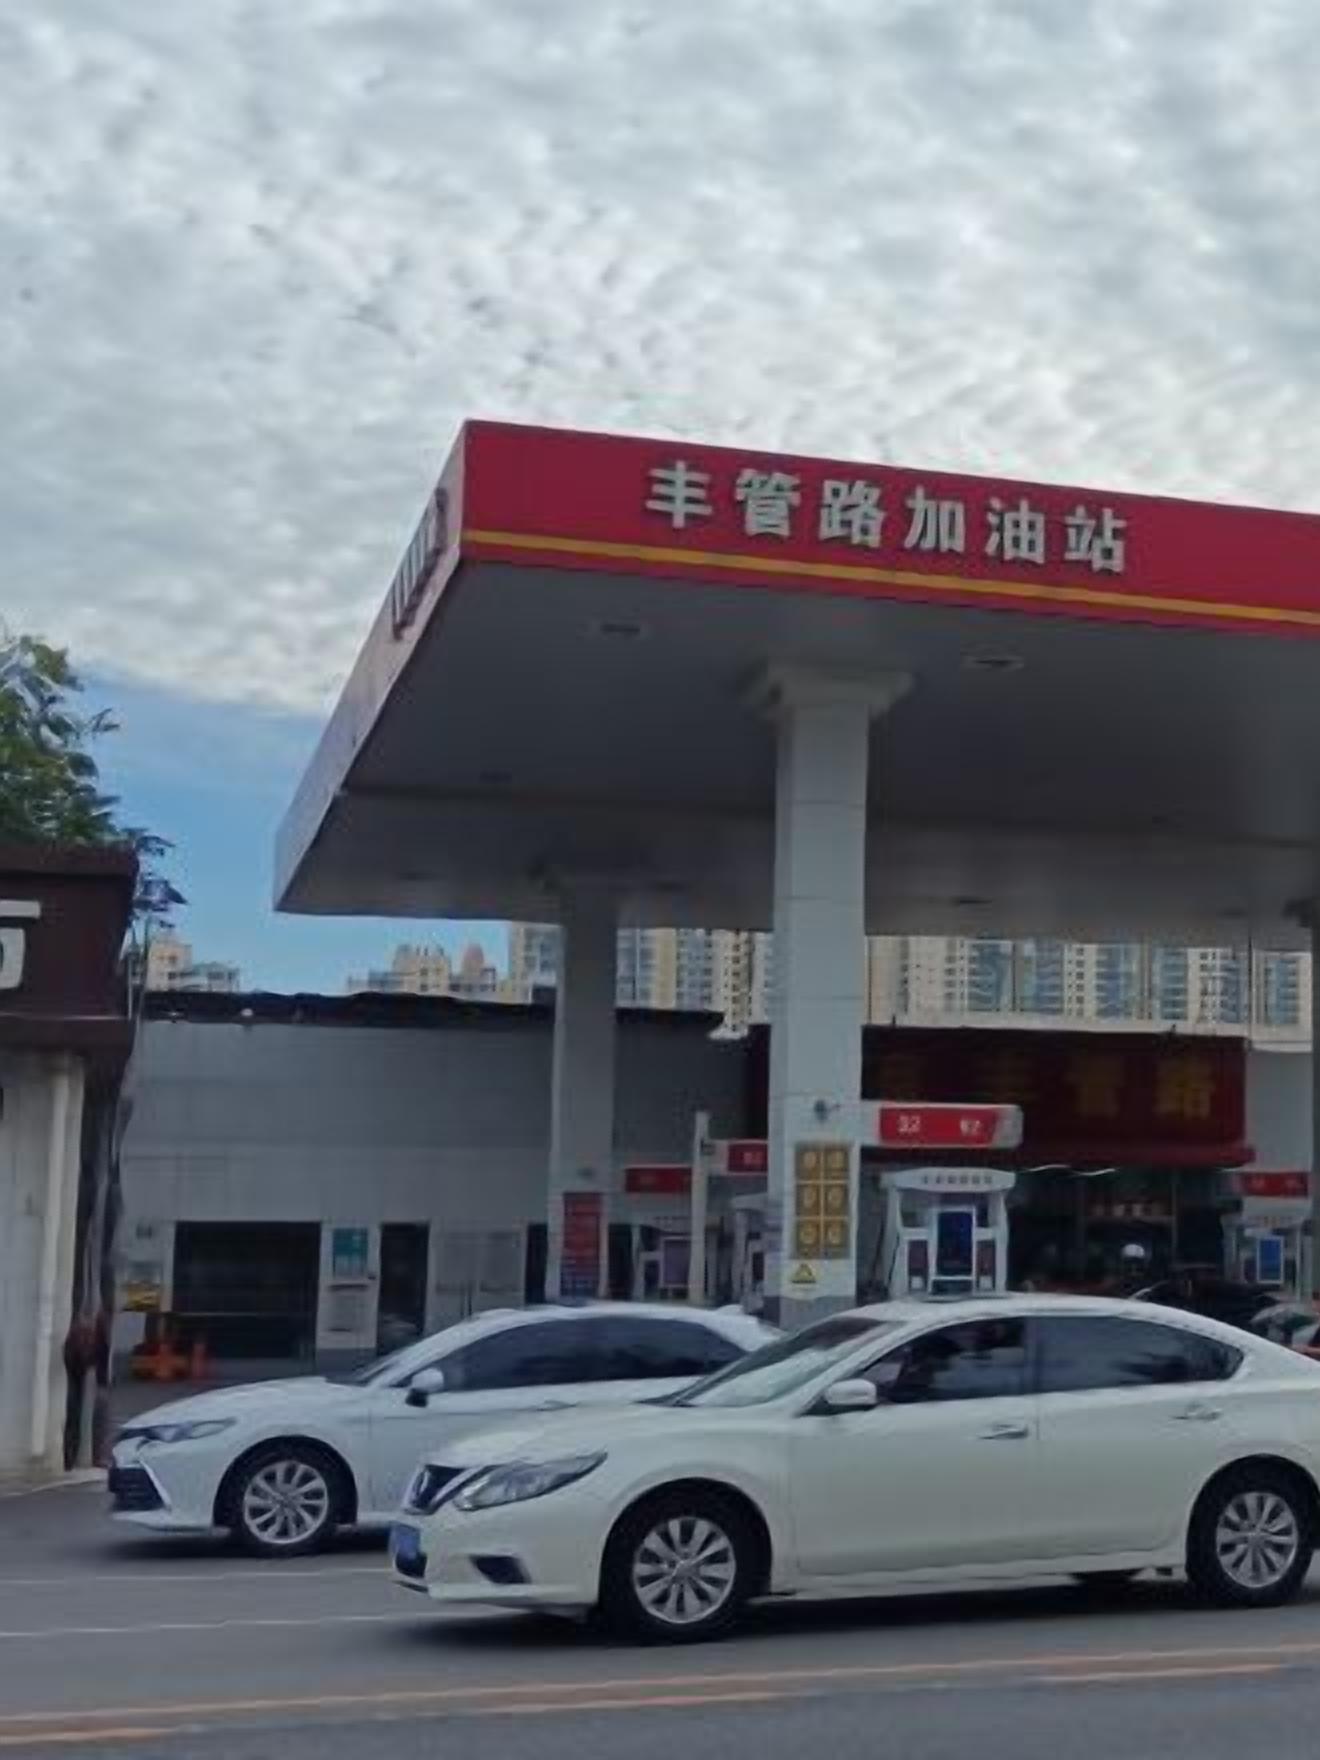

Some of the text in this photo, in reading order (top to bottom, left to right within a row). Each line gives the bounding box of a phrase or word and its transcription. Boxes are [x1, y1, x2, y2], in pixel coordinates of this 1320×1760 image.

[645, 460, 1127, 574] 丰管路加油站
